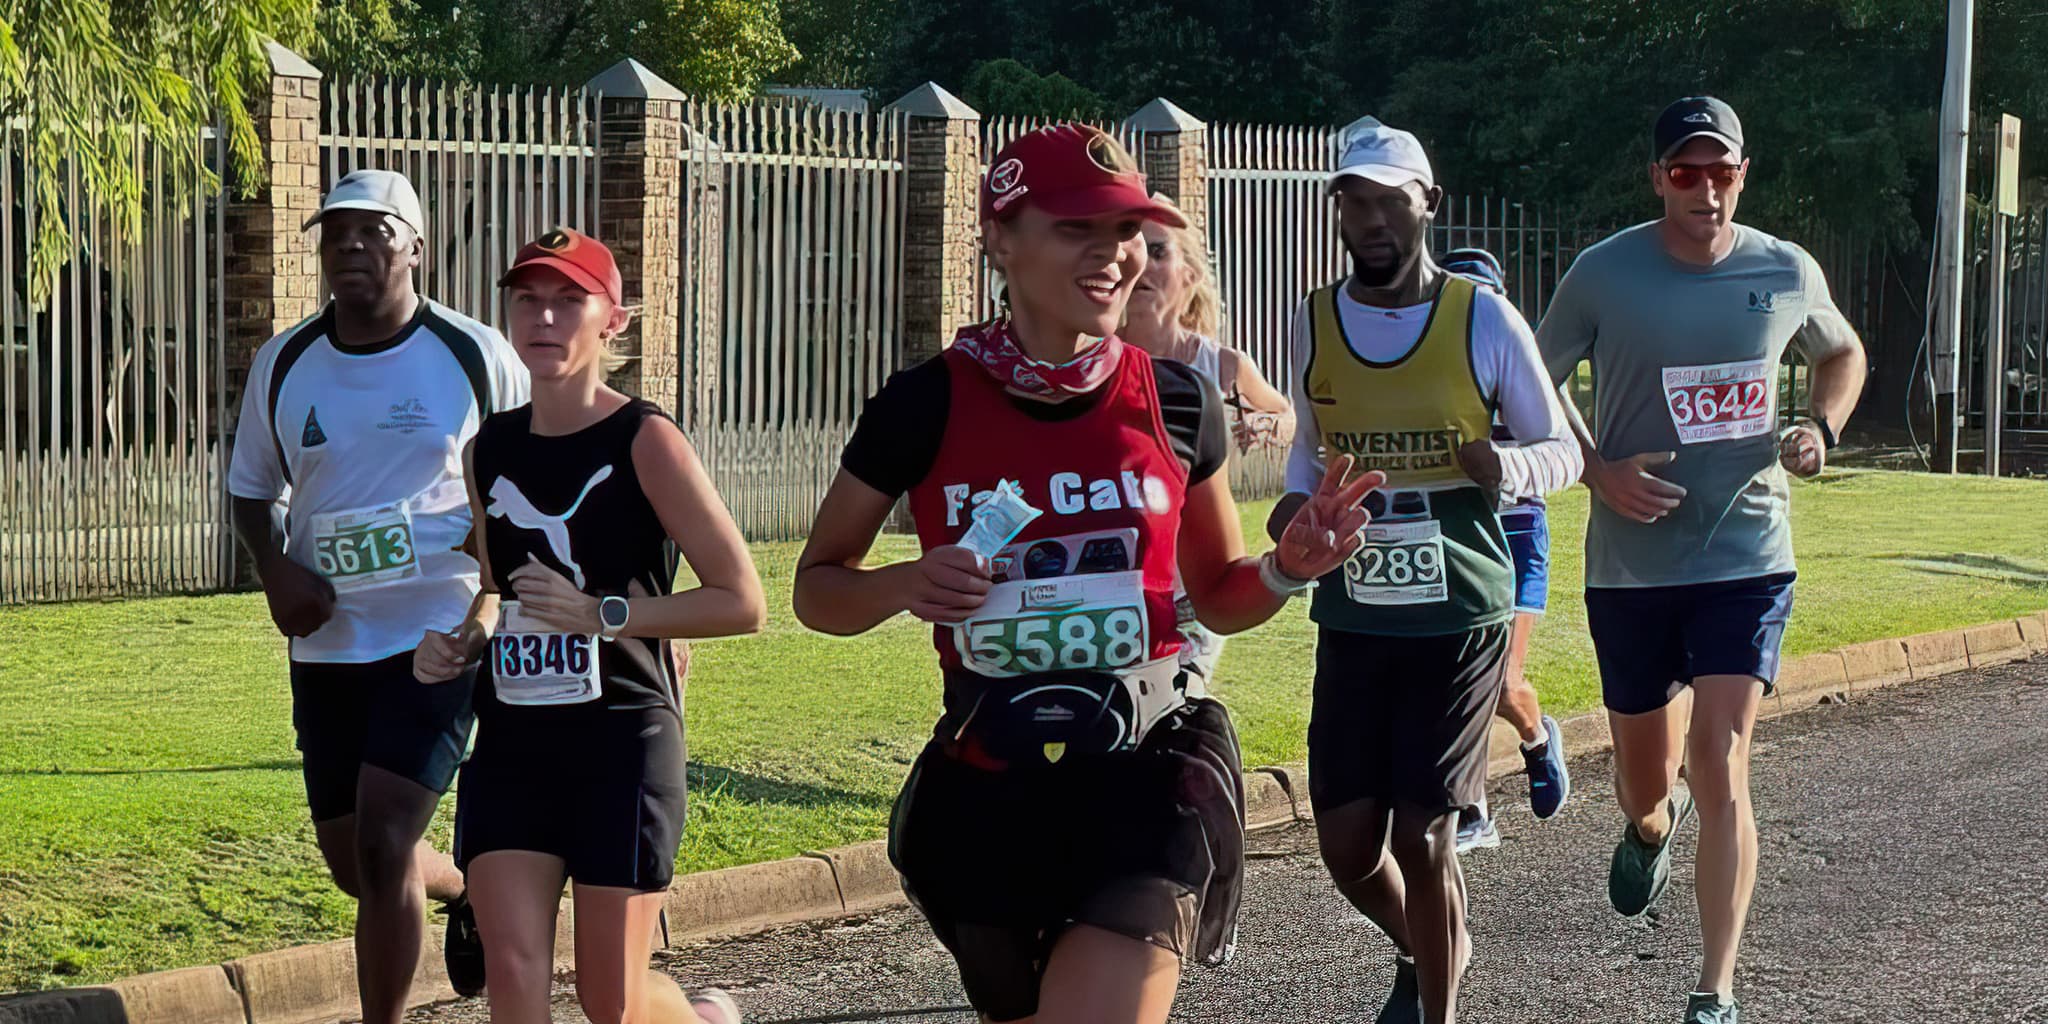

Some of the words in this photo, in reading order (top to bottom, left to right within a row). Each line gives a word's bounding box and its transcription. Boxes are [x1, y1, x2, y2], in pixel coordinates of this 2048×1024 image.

[1669, 382, 1766, 425] 3642
[944, 479, 1025, 527] Fa
[313, 526, 412, 575] 5613
[494, 633, 590, 677] 13346
[970, 608, 1142, 672] 5588
